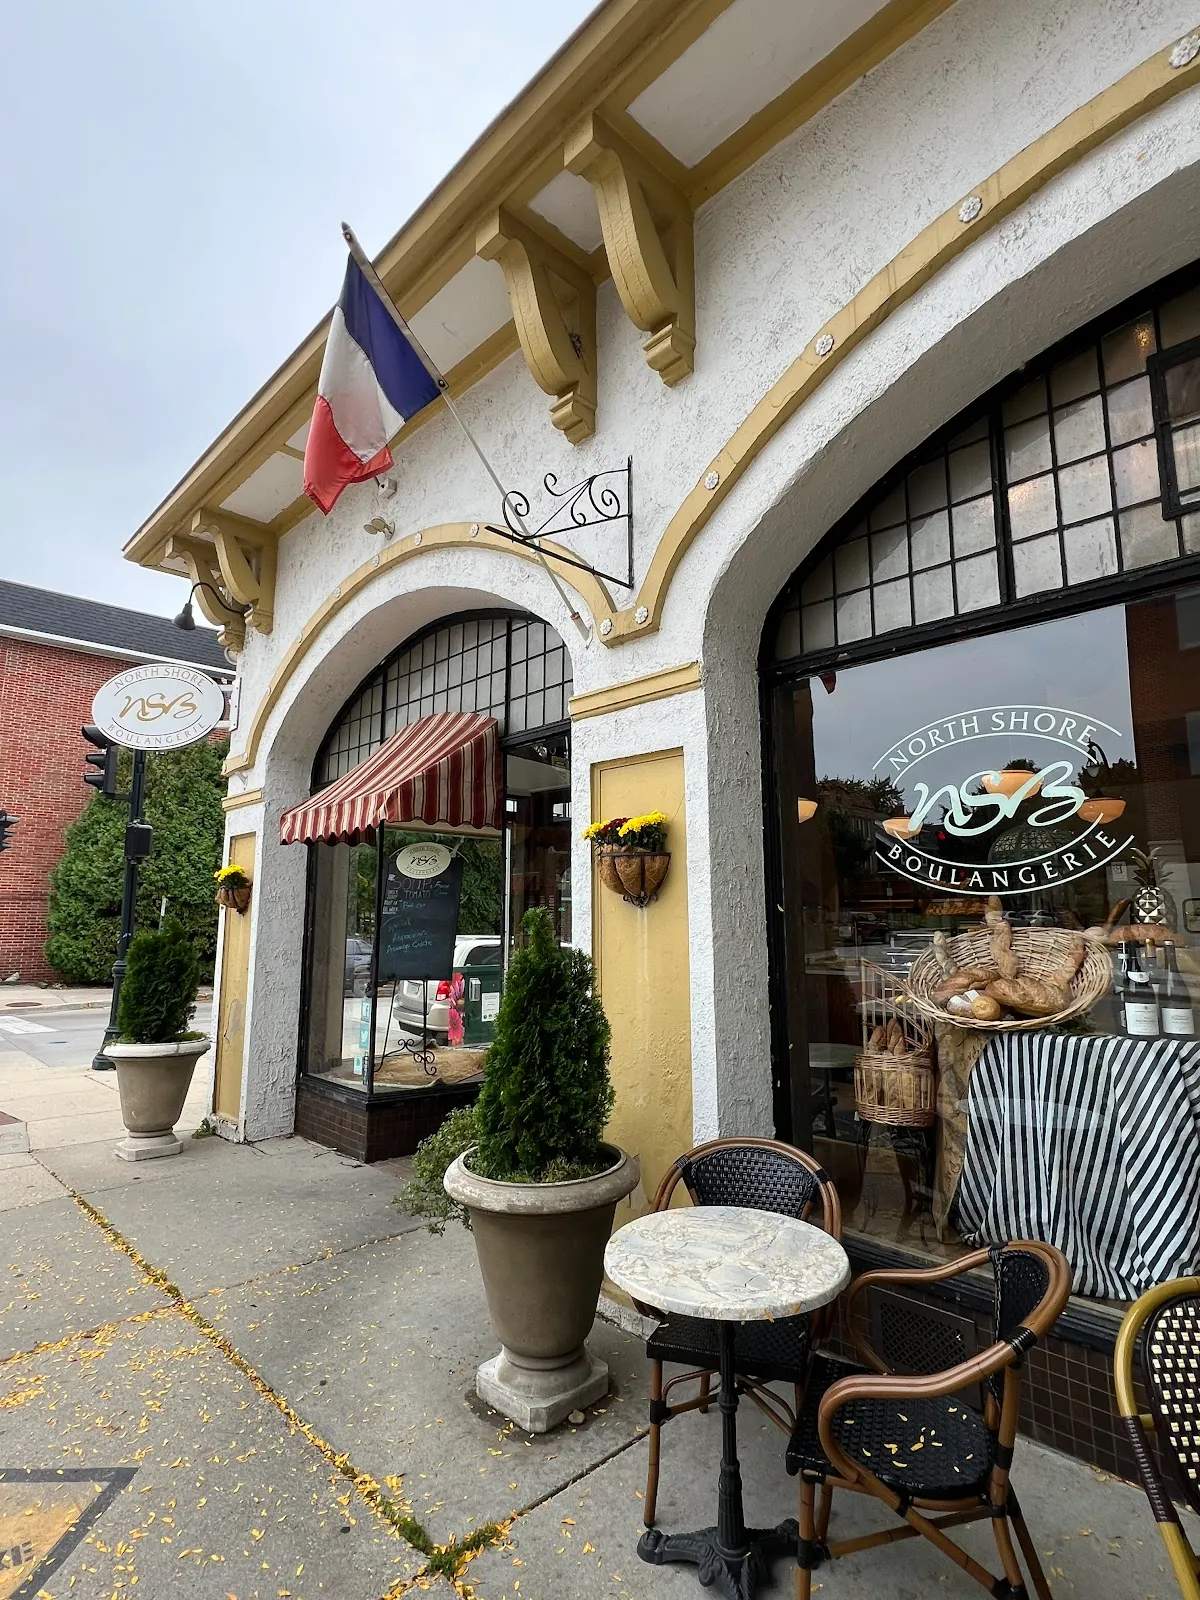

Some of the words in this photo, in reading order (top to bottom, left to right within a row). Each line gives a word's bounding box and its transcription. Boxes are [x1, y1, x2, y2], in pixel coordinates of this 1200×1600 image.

[114, 667, 159, 689] NORTH
[164, 667, 207, 687] SHORE
[106, 722, 208, 746] BOULANGERIE
[888, 715, 979, 772] NORTH
[991, 711, 1097, 747] SHORE
[887, 830, 1117, 888] BOULANGERIE
